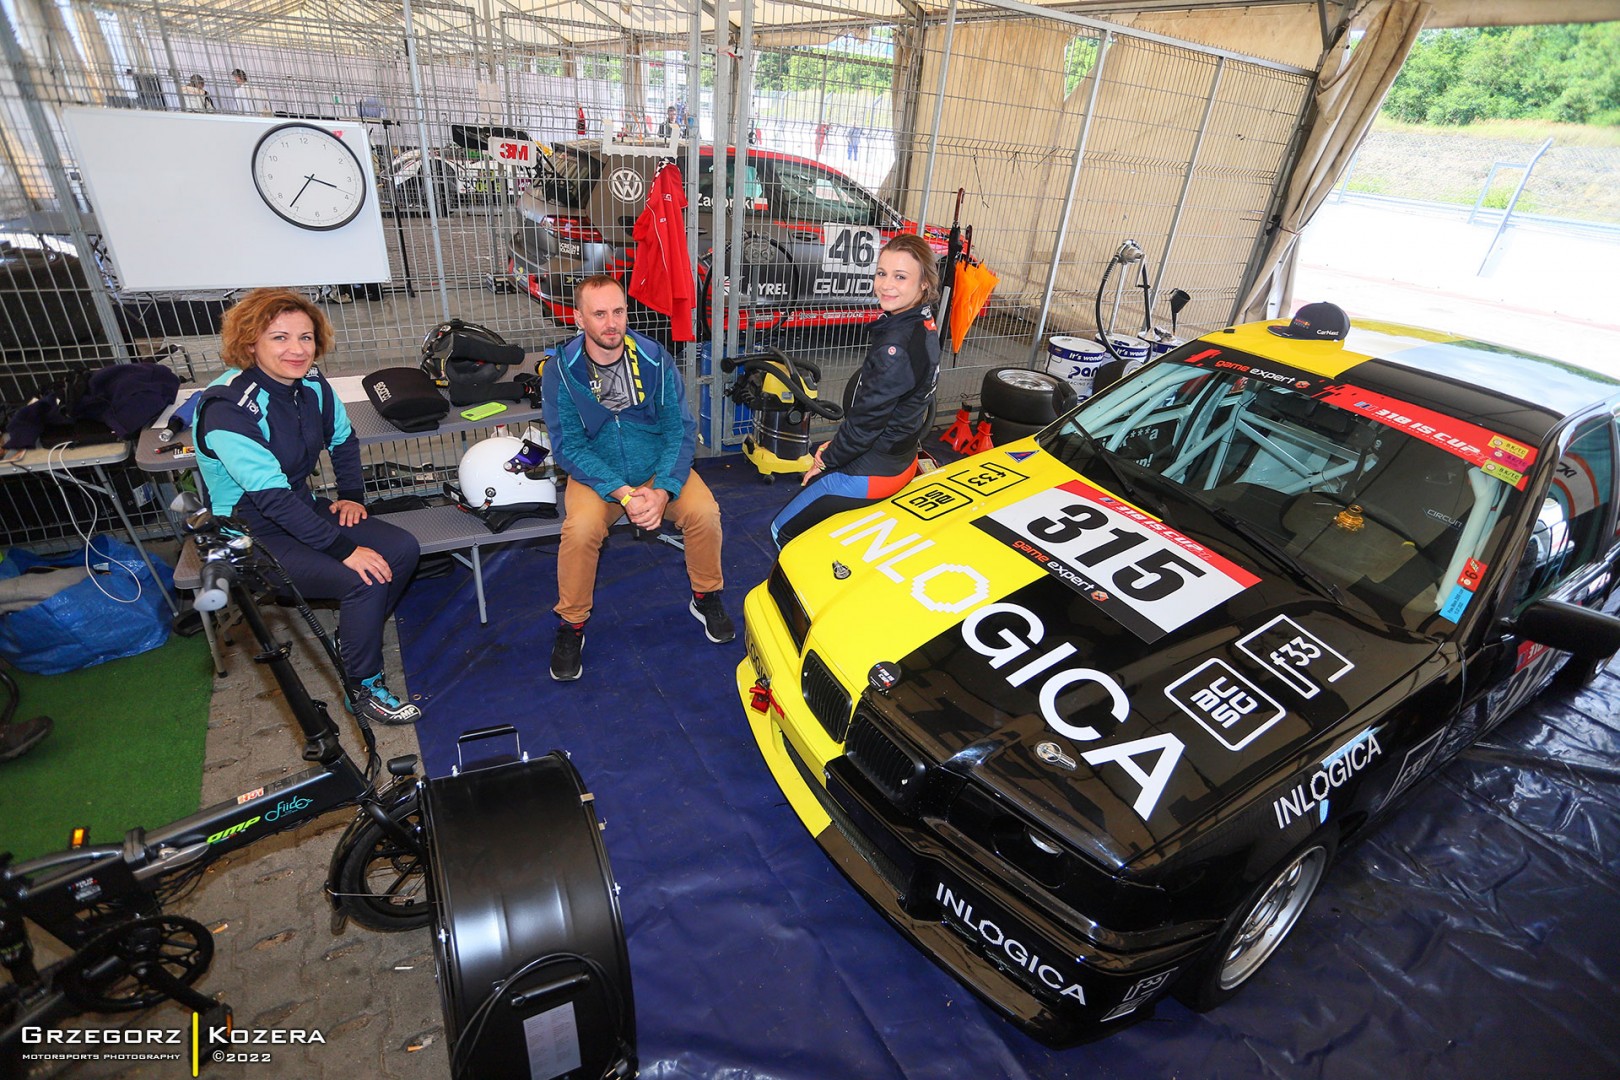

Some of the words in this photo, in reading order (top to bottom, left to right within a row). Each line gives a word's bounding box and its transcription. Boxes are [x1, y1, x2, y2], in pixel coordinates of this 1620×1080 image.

[500, 143, 528, 161] 3M
[829, 229, 874, 268] 46
[1069, 352, 1081, 360] It's
[1215, 360, 1250, 372] game
[1250, 366, 1296, 384] expert
[1375, 408, 1412, 424] 318
[1410, 422, 1436, 434] IS
[1433, 432, 1482, 454] CUP
[1116, 506, 1146, 522] 318
[1144, 518, 1166, 532] IS
[1162, 528, 1204, 550] CUP
[1012, 540, 1050, 563] game
[1046, 560, 1094, 592] expert
[1027, 504, 1207, 602] 315
[828, 510, 1185, 821] INLOGICA
[1270, 636, 1321, 668] f33
[1273, 734, 1382, 829] INLOGICA
[936, 882, 1086, 1006] INLOGICA
